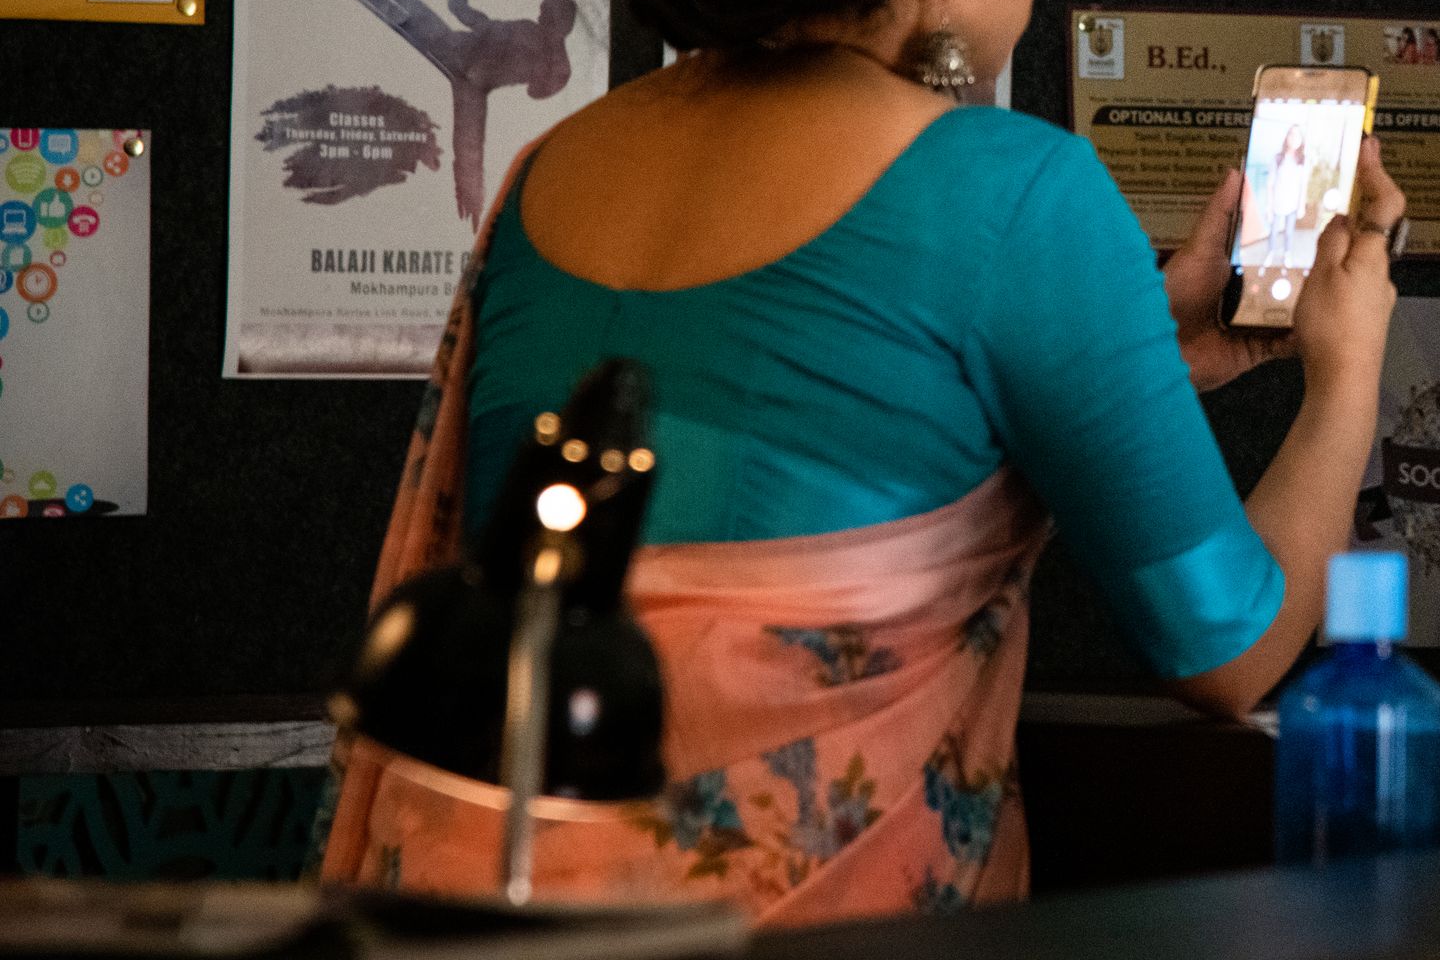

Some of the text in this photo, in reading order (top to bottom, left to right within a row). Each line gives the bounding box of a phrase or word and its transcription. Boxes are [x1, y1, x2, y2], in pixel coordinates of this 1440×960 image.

[1147, 45, 1227, 72] B.Ed.,
[329, 112, 385, 128] Classes
[1108, 109, 1251, 126] OPTIONALS OFFERE
[379, 130, 428, 142] Saturday
[320, 144, 350, 159] 3pm
[362, 146, 393, 160] 6pm
[311, 248, 376, 274] BALAJI
[383, 249, 454, 275] KARATE
[351, 280, 439, 297] Mokhampura
